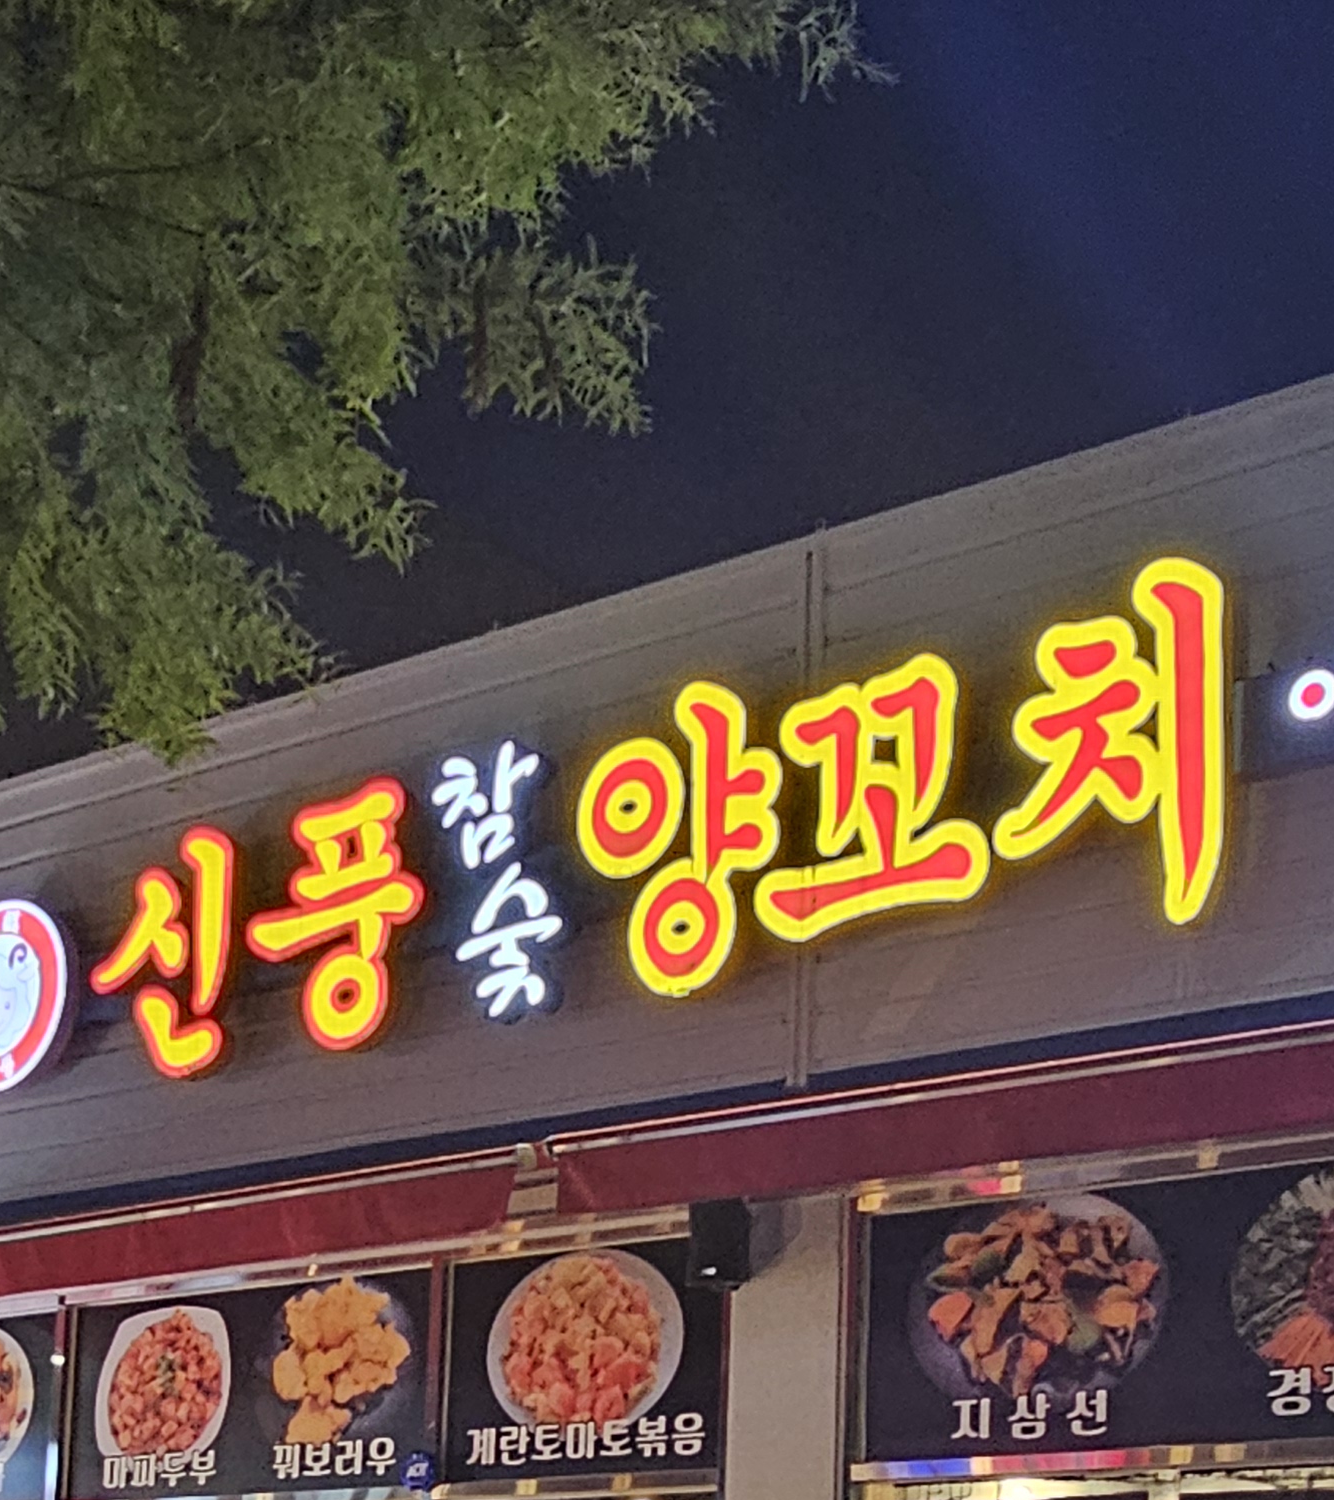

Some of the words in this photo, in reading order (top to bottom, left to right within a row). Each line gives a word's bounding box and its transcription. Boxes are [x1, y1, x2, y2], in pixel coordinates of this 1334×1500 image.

[90, 775, 424, 1078] 신풍
[431, 740, 563, 1018] 참숯
[578, 557, 1224, 998] 양꼬치
[466, 1412, 706, 1466] 계란토마토볶음
[950, 1388, 1111, 1443] 지삼선
[102, 1450, 217, 1489] 마파두부
